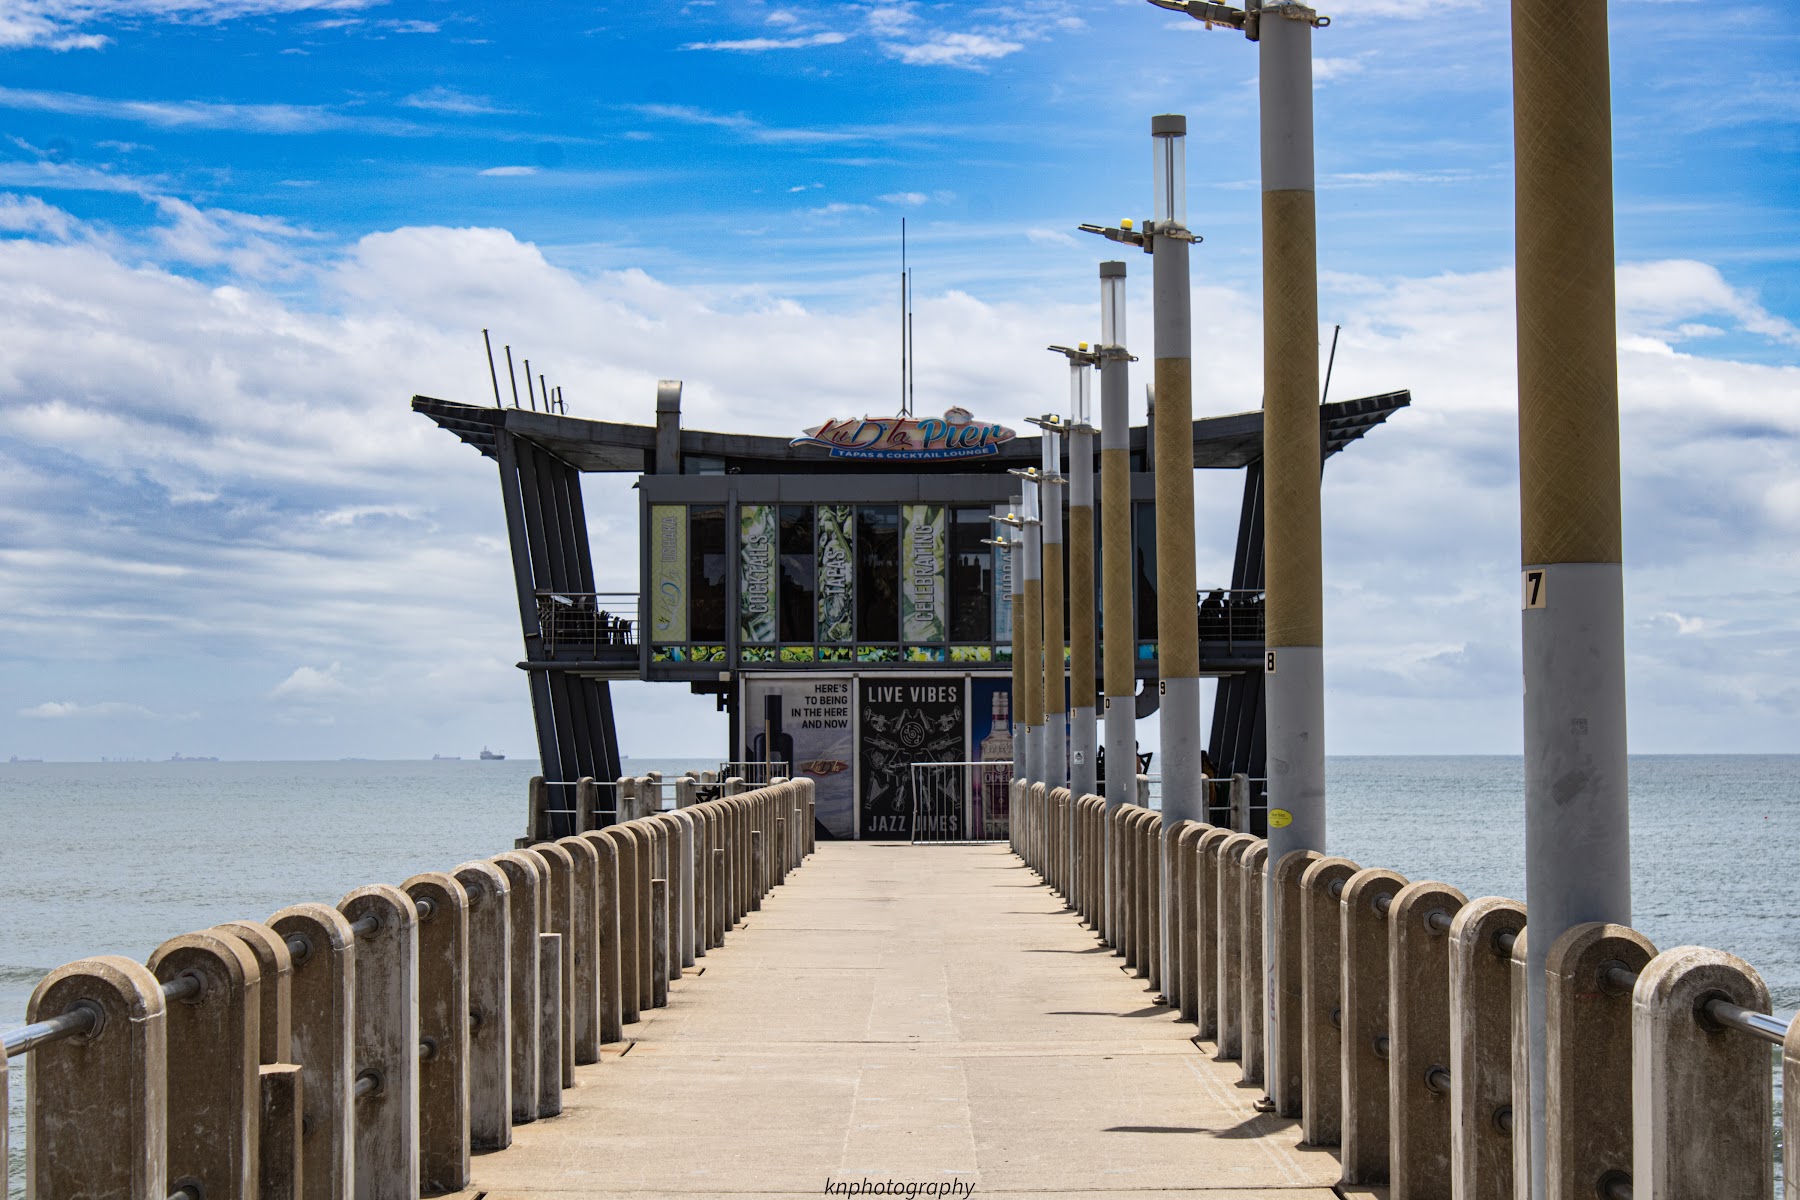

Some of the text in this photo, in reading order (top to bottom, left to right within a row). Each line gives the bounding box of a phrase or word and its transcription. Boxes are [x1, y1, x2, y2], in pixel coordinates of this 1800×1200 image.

[917, 418, 1002, 448] Pier
[838, 450, 874, 458] TAPAS
[886, 451, 942, 459] COCKTAIL
[944, 448, 990, 457] LOUNGE
[662, 515, 678, 562] USHAKA
[749, 535, 769, 613] COCKTAILS
[826, 549, 846, 595] TAPAS
[914, 524, 935, 622] CELEBRATING
[1528, 572, 1542, 605] 7
[1267, 652, 1274, 671] 8
[815, 684, 848, 693] HERE'S
[868, 686, 957, 703] LIVE VIBES
[1160, 681, 1166, 695] 9
[805, 696, 848, 705] TO BEING
[791, 708, 848, 717] IN THE HERE
[1045, 714, 1050, 722] 2
[802, 720, 848, 729] AND NOW
[868, 815, 958, 832] JAZZ JIVES
